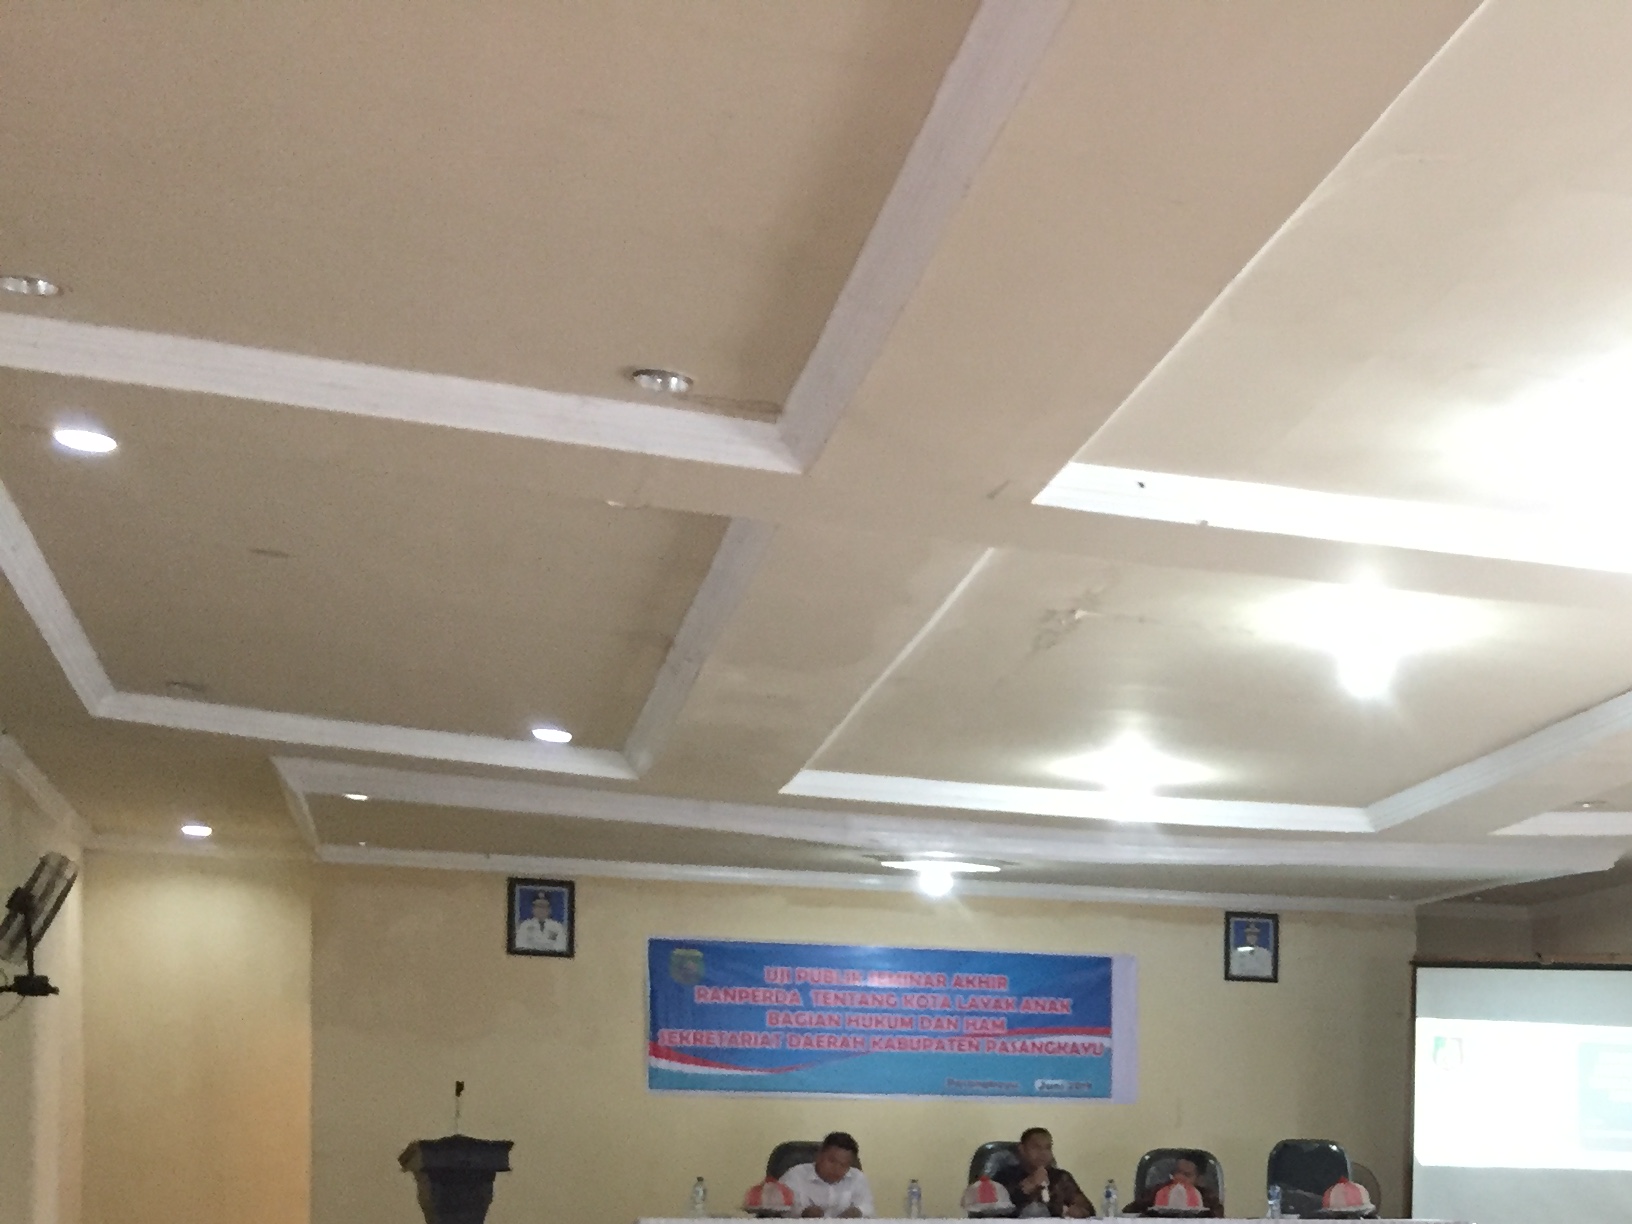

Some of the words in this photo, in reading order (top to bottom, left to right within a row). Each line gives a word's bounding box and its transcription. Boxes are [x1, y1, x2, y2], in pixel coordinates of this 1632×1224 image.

[764, 966, 791, 984] UJI
[796, 967, 863, 986] PUBLIK
[951, 973, 1009, 990] AKHIR
[695, 985, 802, 1005] RANPERDA
[811, 989, 898, 1008] TENTANG
[902, 993, 951, 1010] KOTA
[955, 995, 1017, 1012] LAYAK
[1019, 998, 1072, 1014] ANAK
[766, 1010, 842, 1027] BAGIAN
[845, 1012, 915, 1030] HUKUM
[918, 1015, 959, 1031] DAN
[963, 1017, 1007, 1033] HAM
[658, 1029, 782, 1048] SEKRETARIAT
[787, 1033, 866, 1050] DAERAH
[871, 1036, 981, 1053] KABUPATEN
[984, 1039, 1105, 1057] PASANGKAYU
